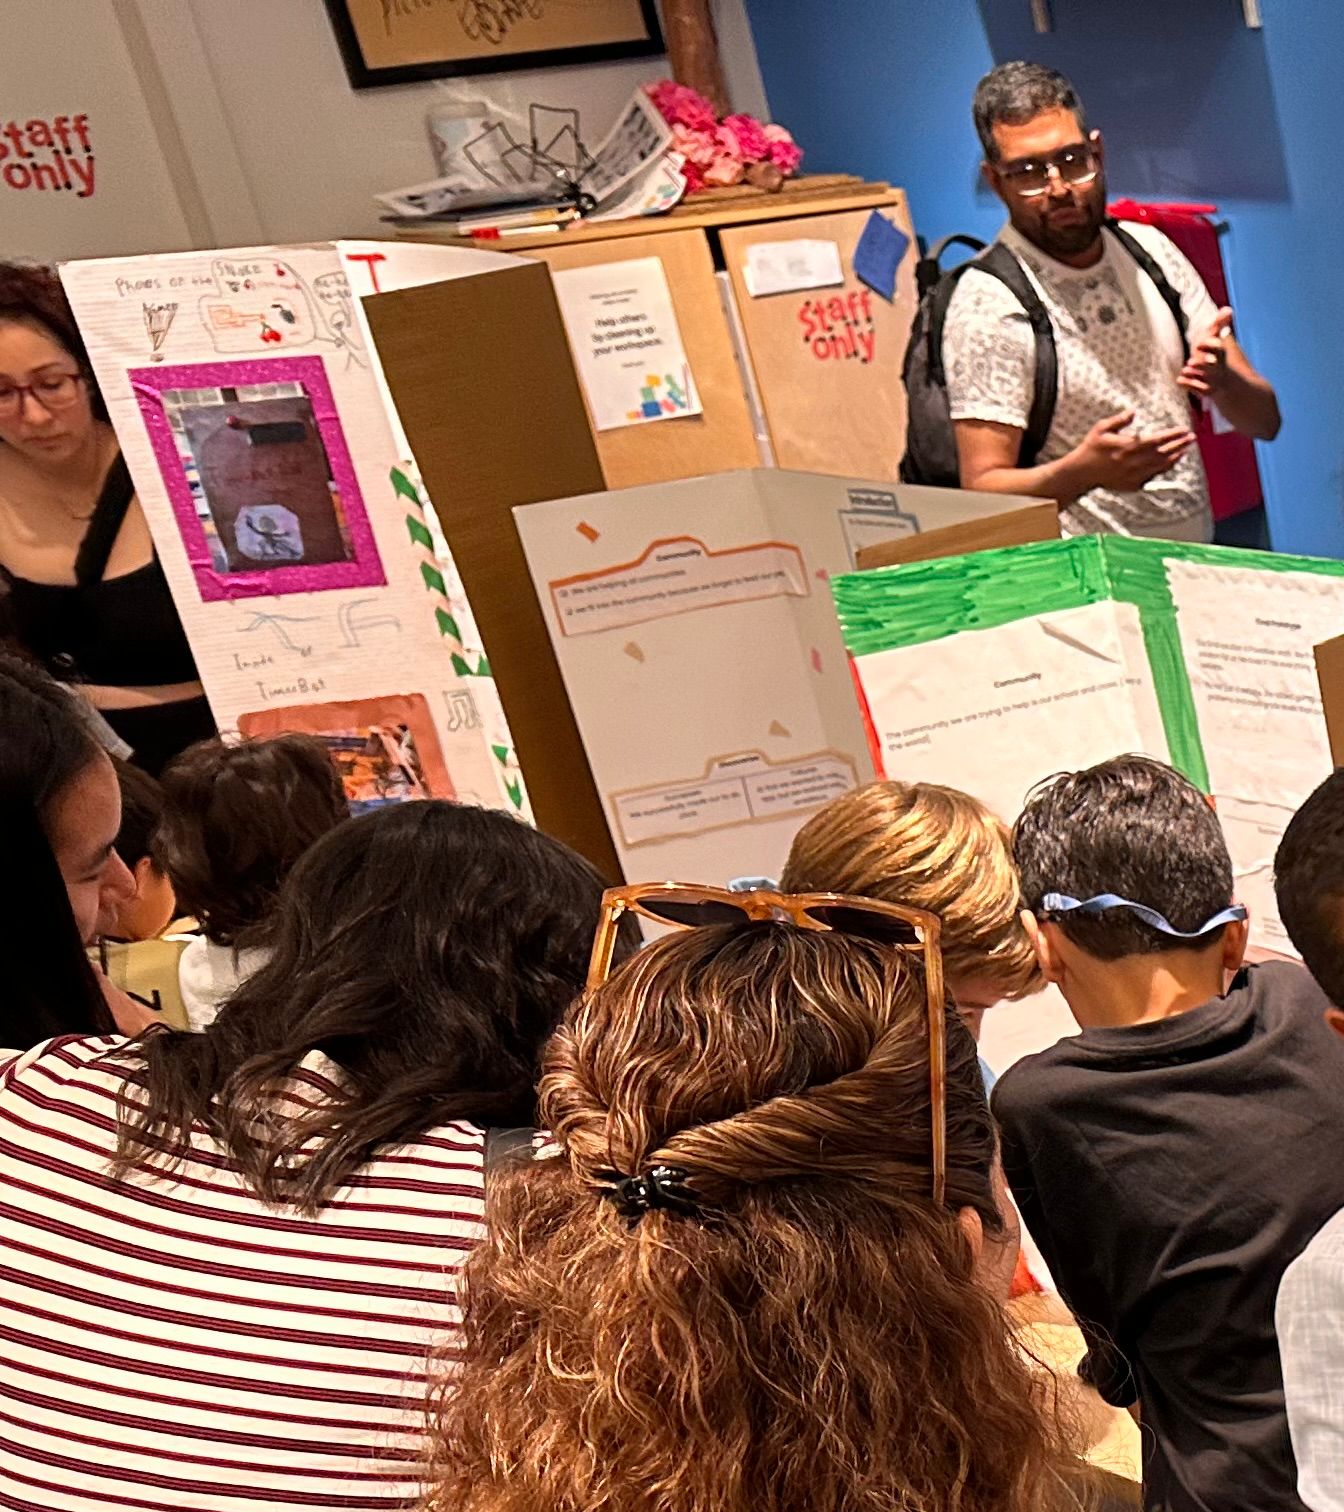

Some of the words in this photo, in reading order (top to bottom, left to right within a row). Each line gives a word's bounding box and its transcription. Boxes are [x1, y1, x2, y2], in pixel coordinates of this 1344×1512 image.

[3, 150, 95, 198] only
[798, 288, 872, 343] Staff
[812, 322, 876, 365] only
[993, 672, 1042, 689] Community
